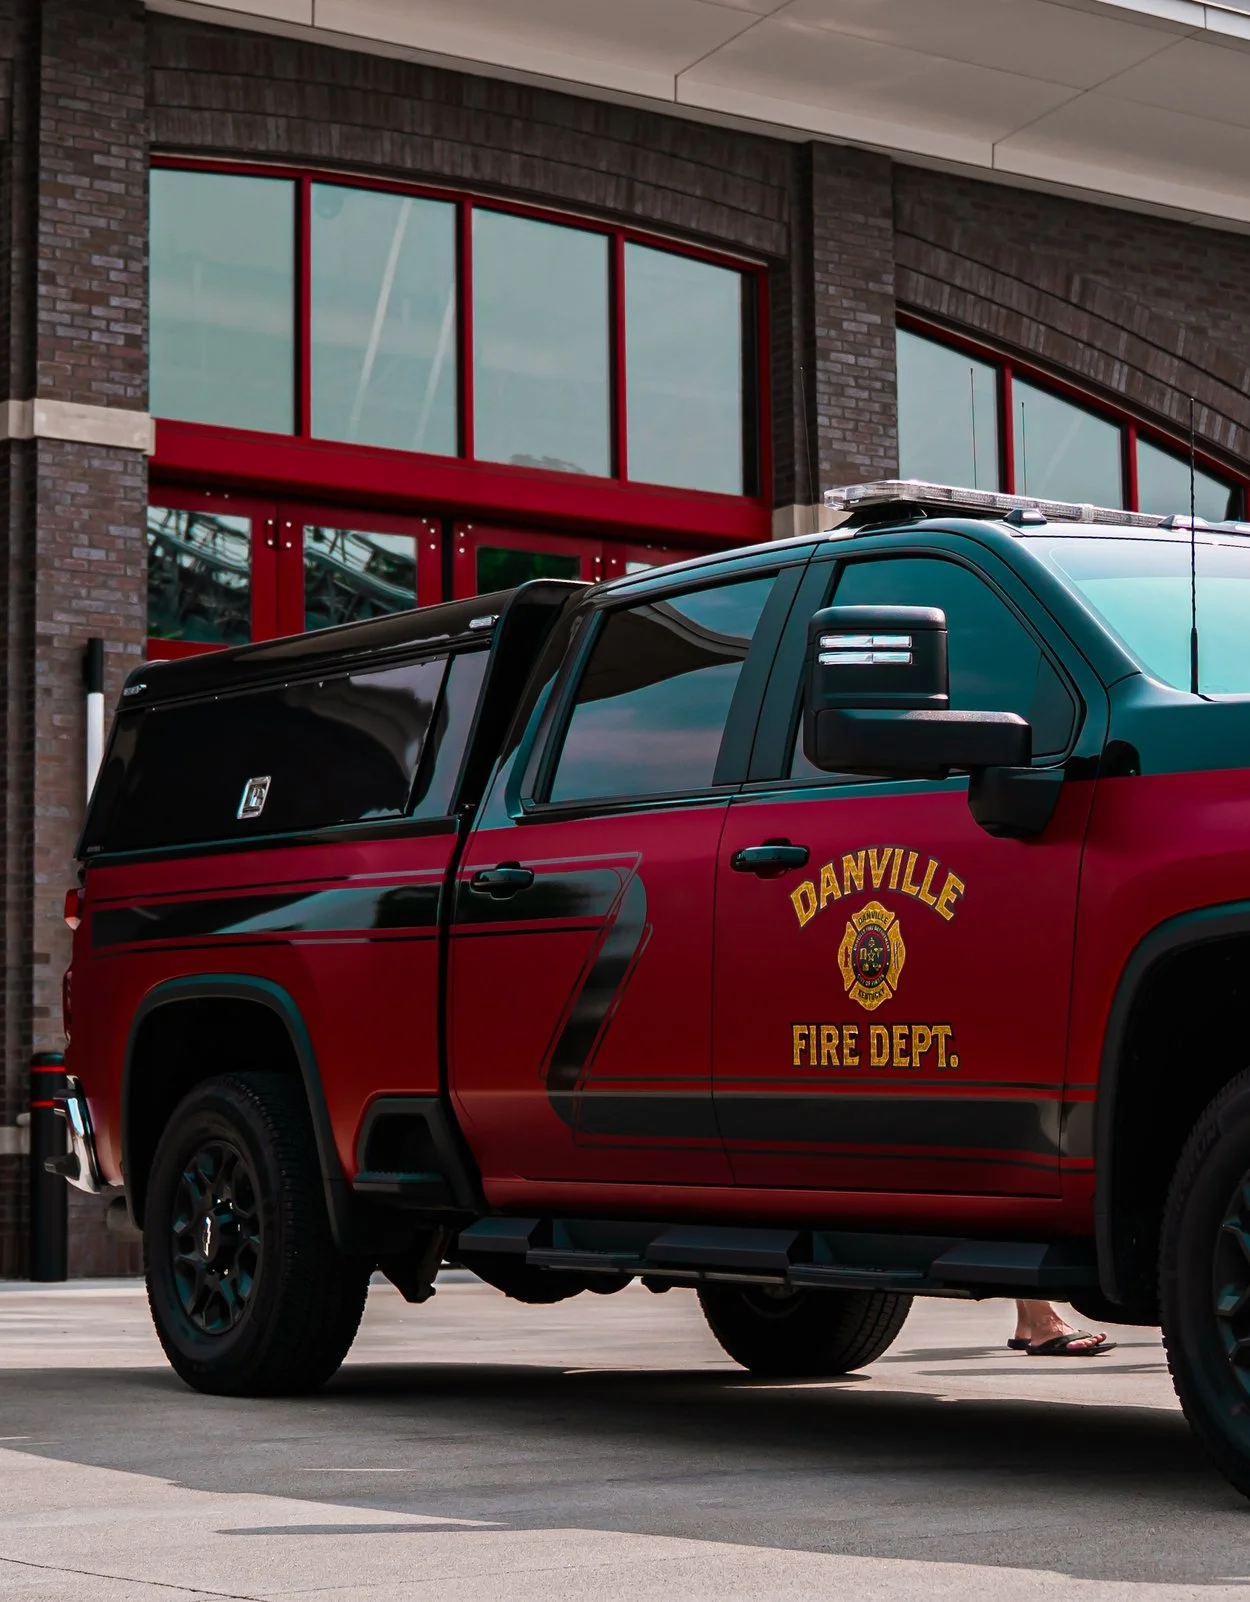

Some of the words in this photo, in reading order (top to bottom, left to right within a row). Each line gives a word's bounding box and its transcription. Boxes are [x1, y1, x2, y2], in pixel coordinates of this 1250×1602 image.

[790, 847, 965, 928] DANVILLE
[858, 911, 889, 924] DANVILLE
[858, 987, 885, 1001] KENTUCKY
[792, 1024, 860, 1067] FIRE
[869, 1024, 959, 1068] DEPT.
